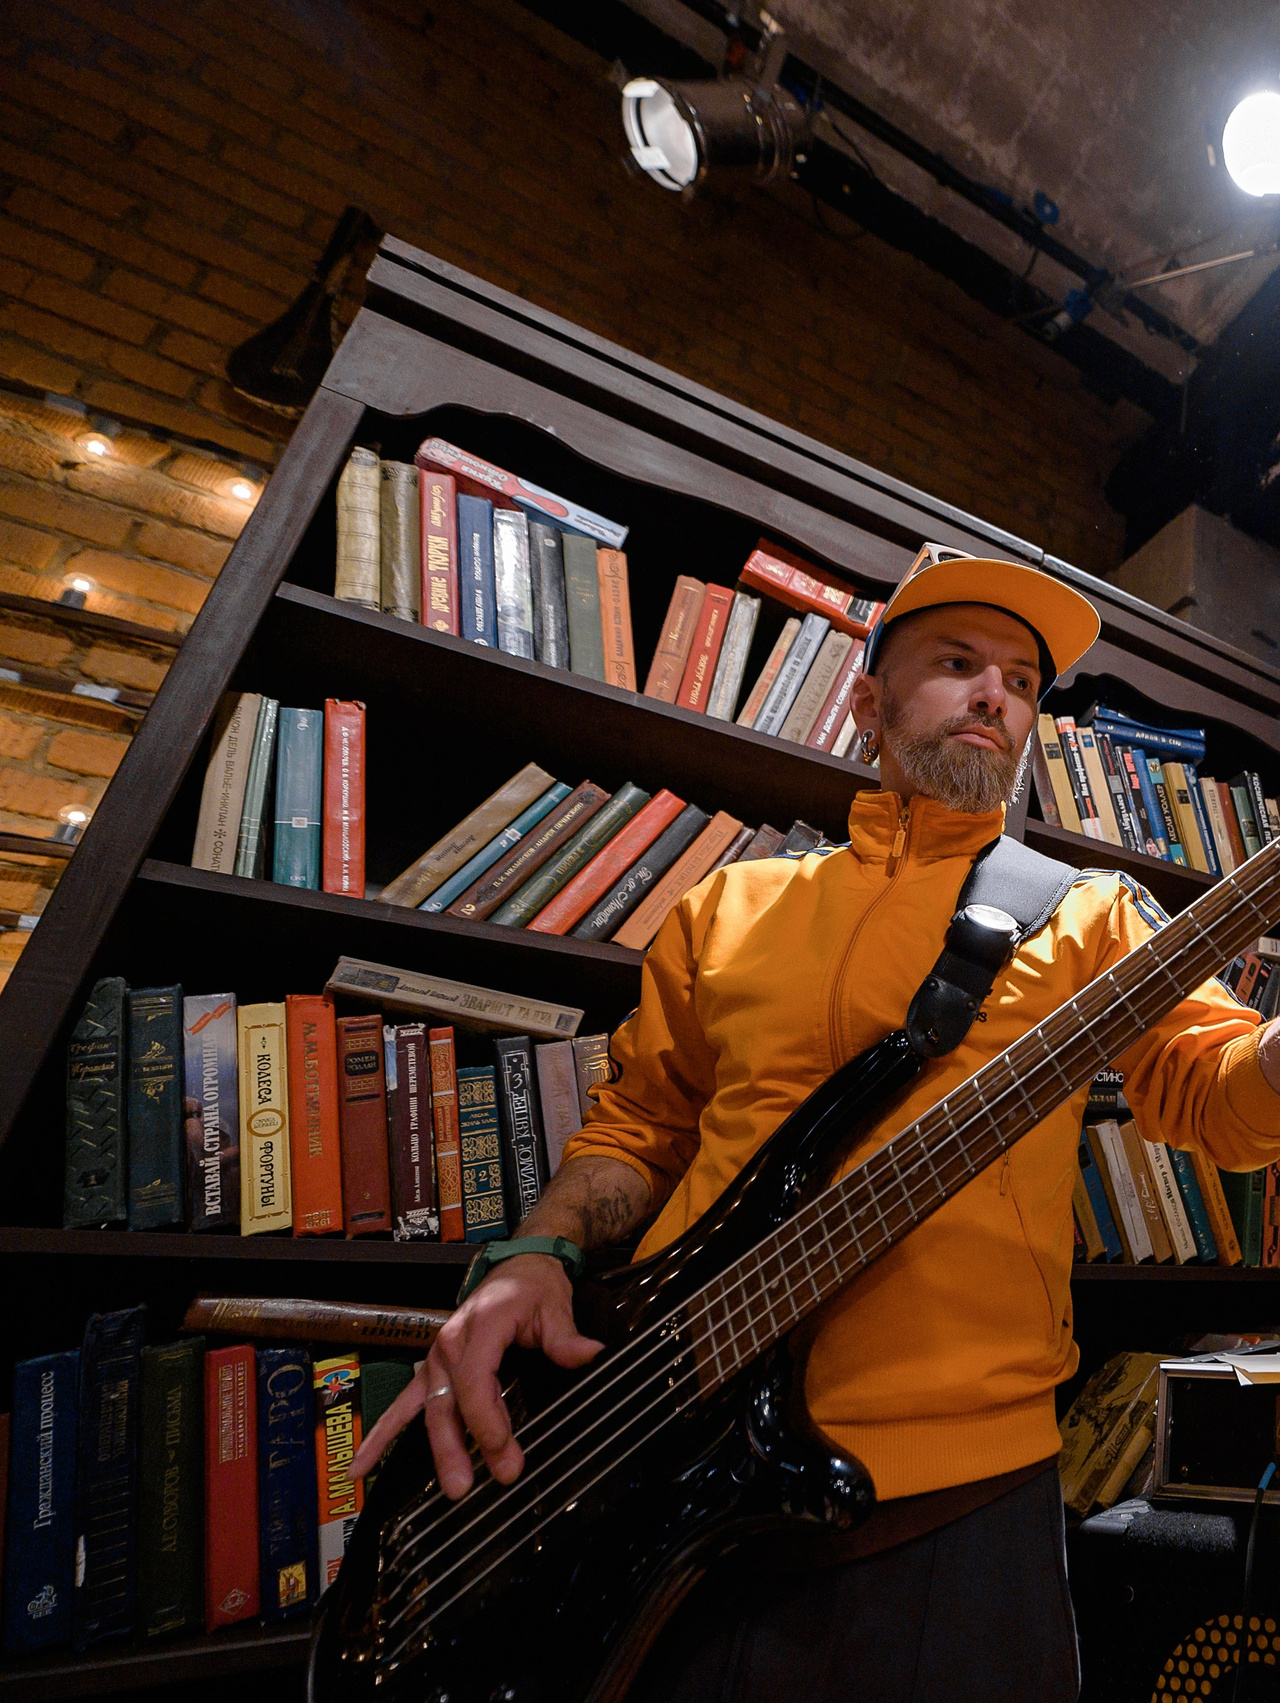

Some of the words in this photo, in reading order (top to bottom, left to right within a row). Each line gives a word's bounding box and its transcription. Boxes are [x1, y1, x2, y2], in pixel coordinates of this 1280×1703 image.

[426, 534, 450, 571] ТЮРКИ
[429, 576, 449, 613] ДРЕВНИЕ
[693, 653, 710, 680] ВОКРУГ
[686, 680, 703, 704] ТРОНА
[814, 731, 826, 745] КАК
[820, 704, 840, 732] ДОБЫЛИ
[833, 670, 857, 705] СОВЕТСКИЙ
[225, 735, 239, 759] ДЕЛЬ
[214, 759, 236, 826] ВАЛЬЕ-ИНКЛАН
[1156, 783, 1170, 814] УОЛЛЕР
[1250, 775, 1270, 828] КОСМИЧЕСКАЯ
[1164, 814, 1178, 842] ЛЕСЛИ
[460, 901, 476, 917] 2
[459, 992, 515, 1018] ЭВАРИСТ
[202, 1030, 218, 1101] ОГРОМНАЯ
[347, 1054, 375, 1063] РОМЕН
[347, 1061, 377, 1070] РОЛЛАН
[403, 1041, 418, 1093] ШЕРЕМЕТЕВОЙ
[257, 1053, 271, 1104] КОЛЕСА
[512, 1072, 523, 1087] 3
[202, 1101, 219, 1151] СТРАНА
[408, 1095, 418, 1130] ГРАФИНИ
[511, 1090, 531, 1139] КУПЕР
[410, 1132, 419, 1162] КОЛЬЦО
[200, 1150, 224, 1215] ВСТАВАЙ,
[259, 1141, 274, 1207] ФОРТУНЫ
[477, 1168, 489, 1182] 2
[1158, 1169, 1176, 1198] Мастер
[222, 1364, 232, 1389] ПРАВО
[36, 1369, 57, 1427] процесс
[165, 1384, 182, 1446] ПИСЬМА
[325, 1402, 352, 1491] МАЛЫШЕВА
[30, 1429, 60, 1530] Гражданский
[162, 1463, 180, 1530] СУВОРОВ
